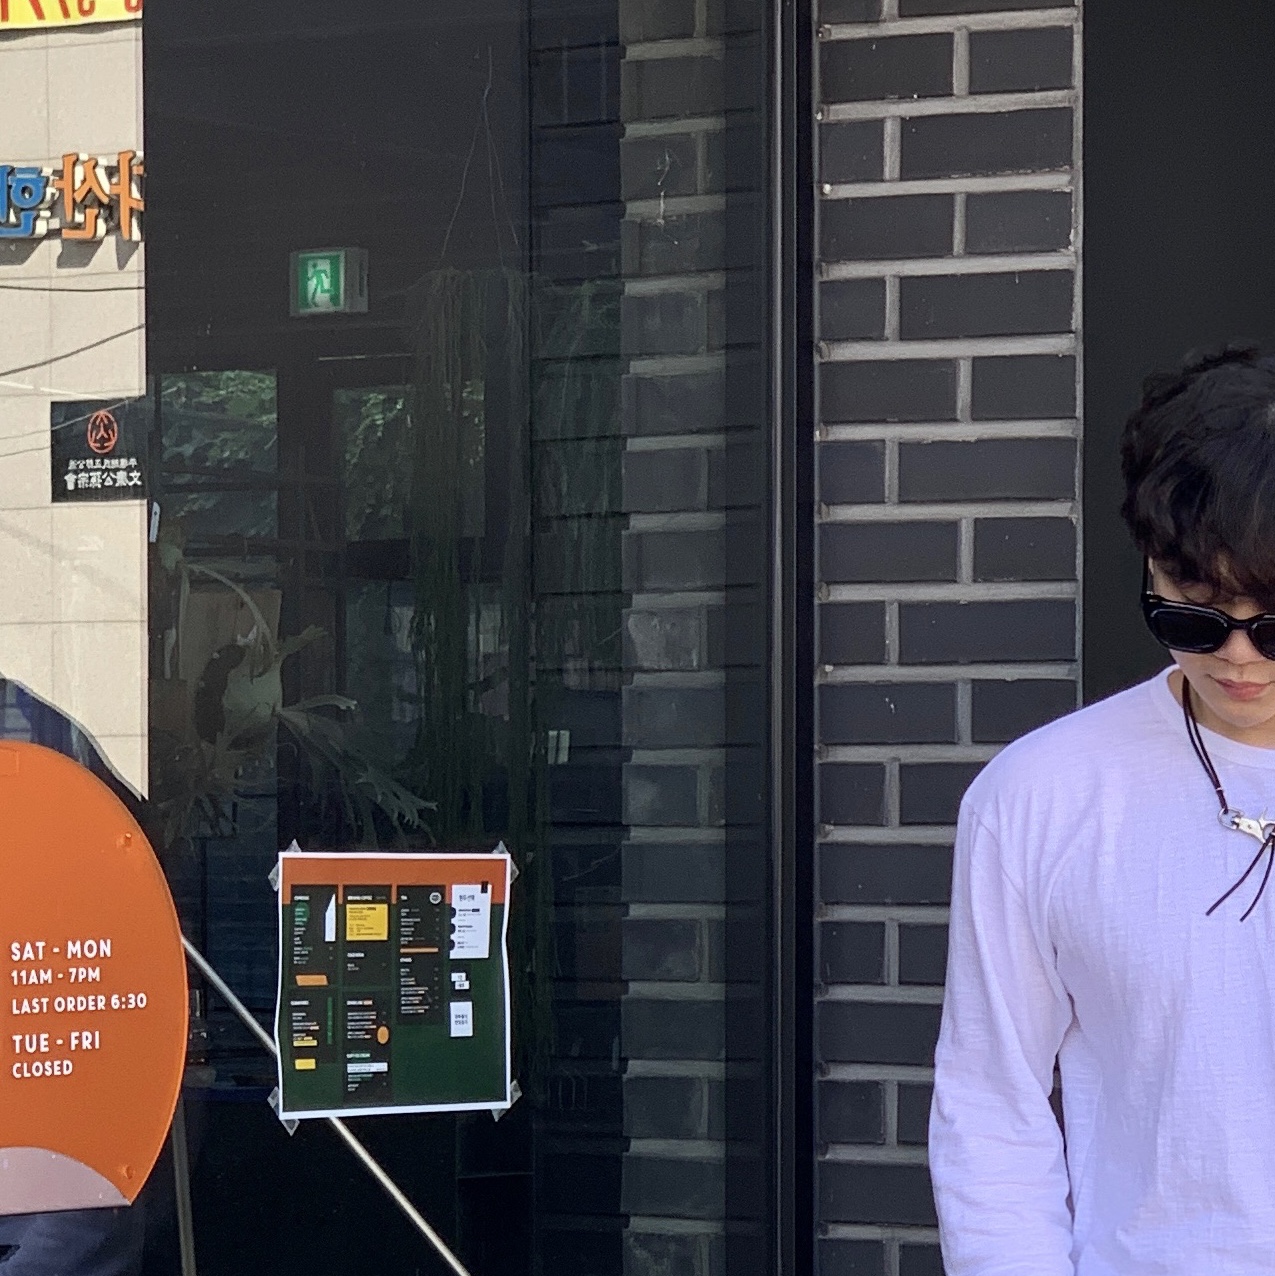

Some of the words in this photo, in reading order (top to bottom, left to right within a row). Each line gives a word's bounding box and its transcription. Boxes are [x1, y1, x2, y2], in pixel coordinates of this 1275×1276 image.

[11, 941, 46, 961] SAT
[67, 938, 111, 959] MON
[11, 968, 52, 985] 11AM
[68, 966, 100, 983] 7PM
[12, 997, 49, 1015] LAST
[54, 994, 106, 1012] ORDER
[111, 992, 147, 1010] 6:30
[12, 1033, 49, 1053] TUE
[70, 1030, 100, 1051] FRI
[12, 1059, 73, 1079] CLOSED
